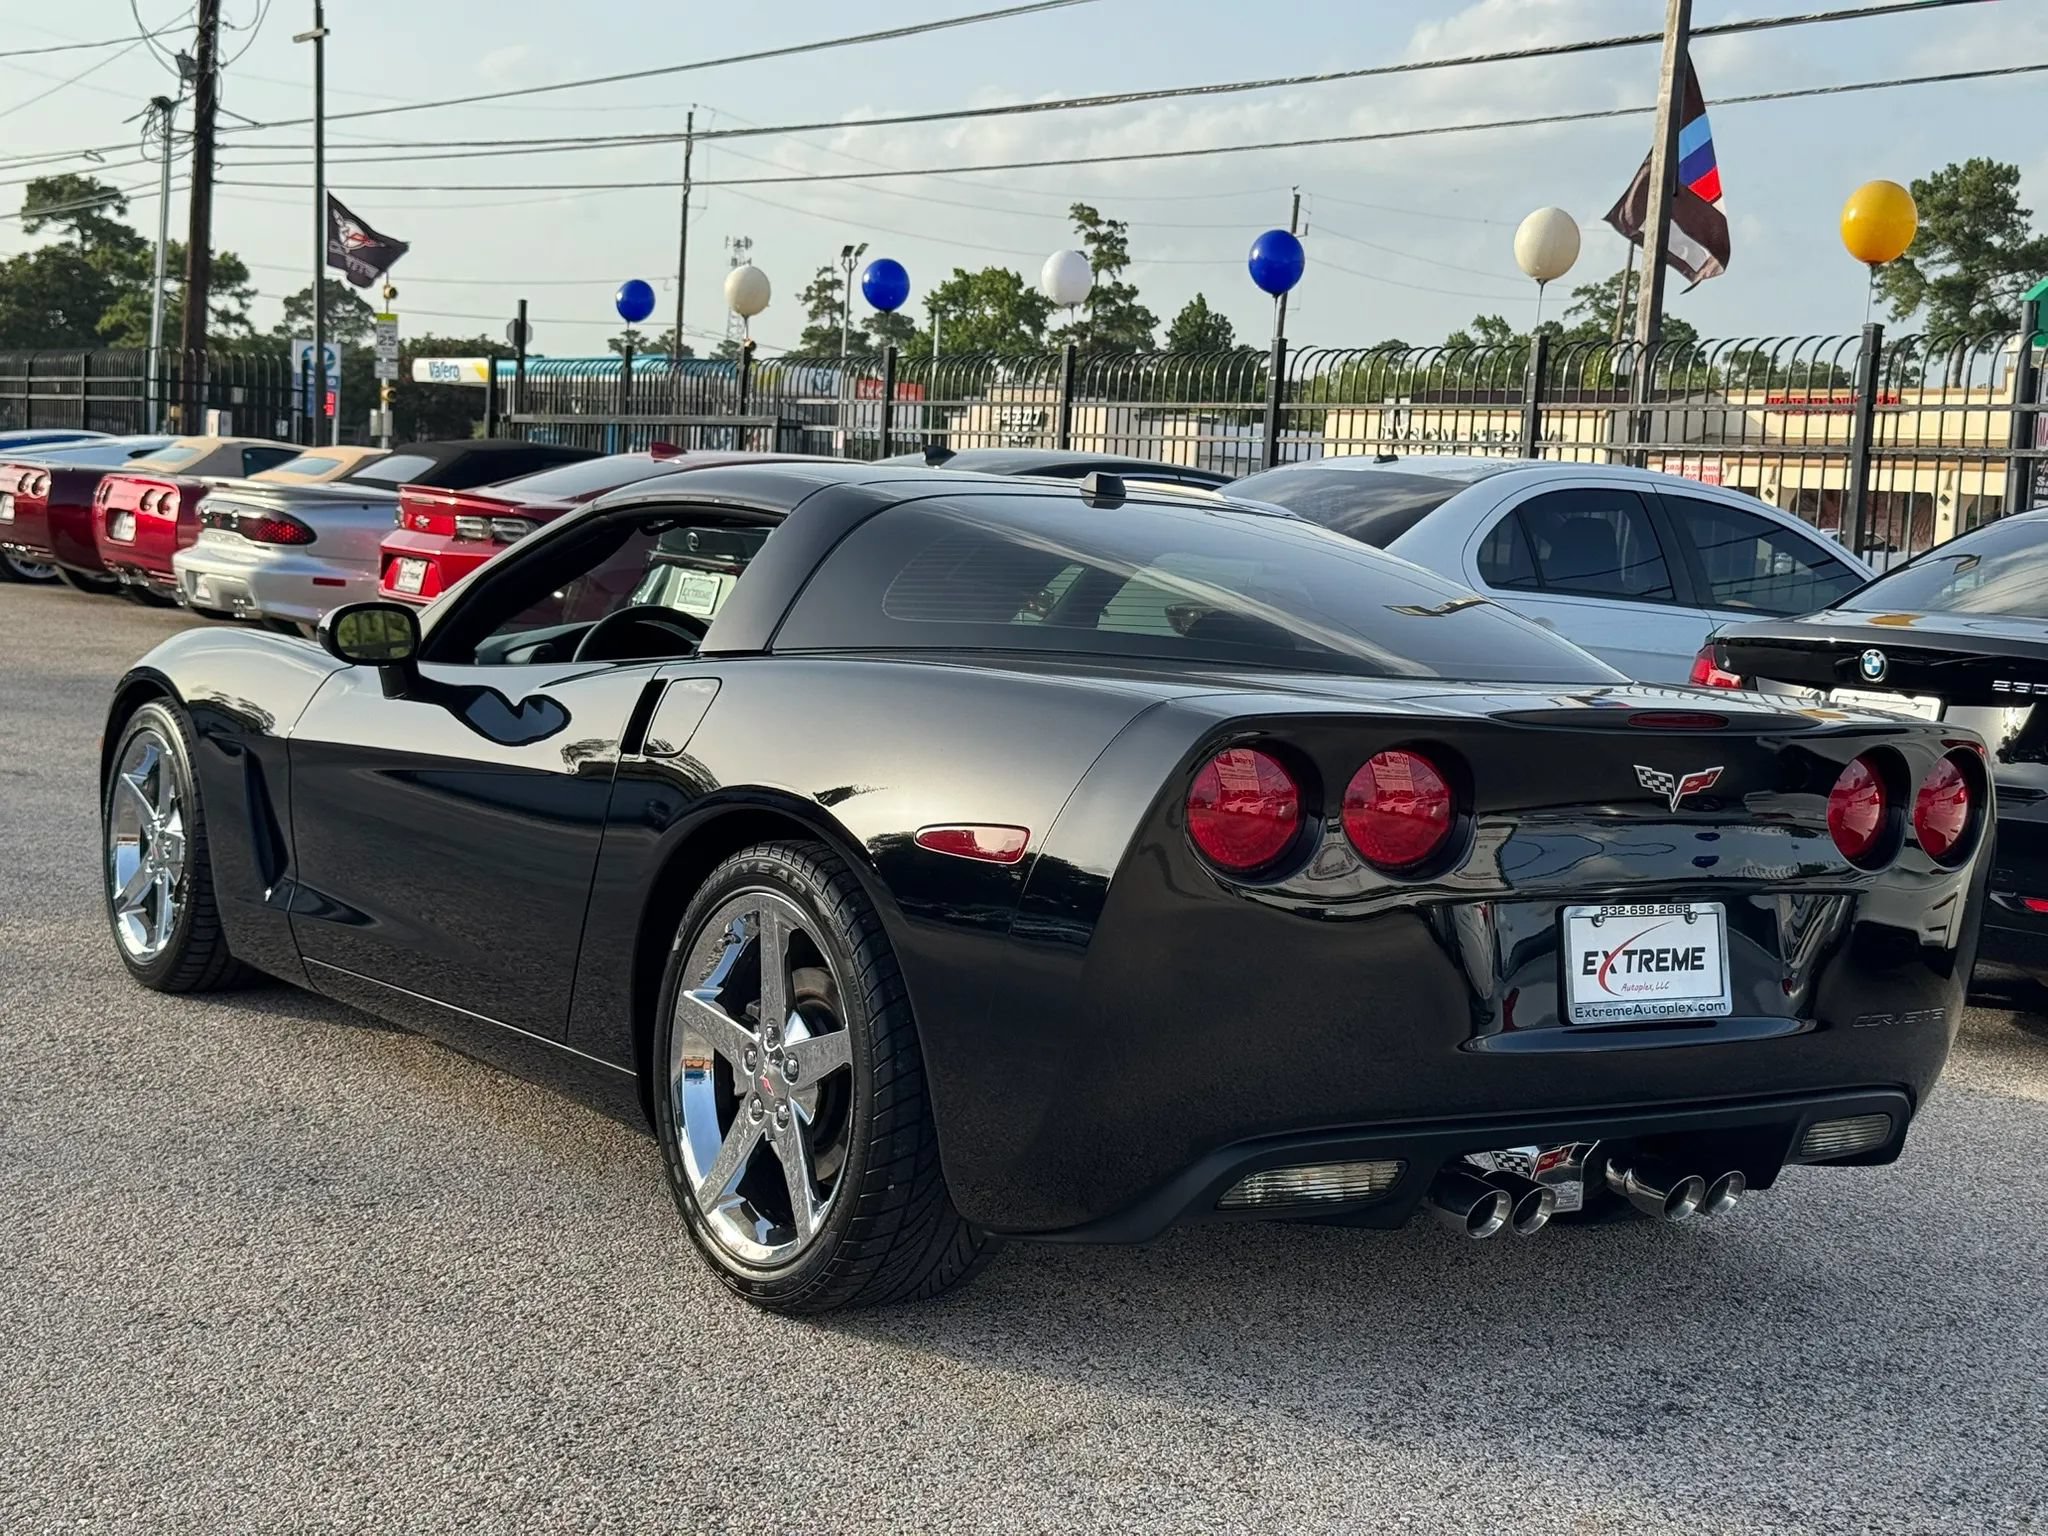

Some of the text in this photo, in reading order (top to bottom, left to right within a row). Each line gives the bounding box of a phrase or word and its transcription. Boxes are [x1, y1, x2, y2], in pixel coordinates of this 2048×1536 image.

[428, 361, 461, 381] Valero
[1582, 946, 1706, 976] EXTREME
[1574, 1002, 1727, 1018] ExtremeAutoplex.com
